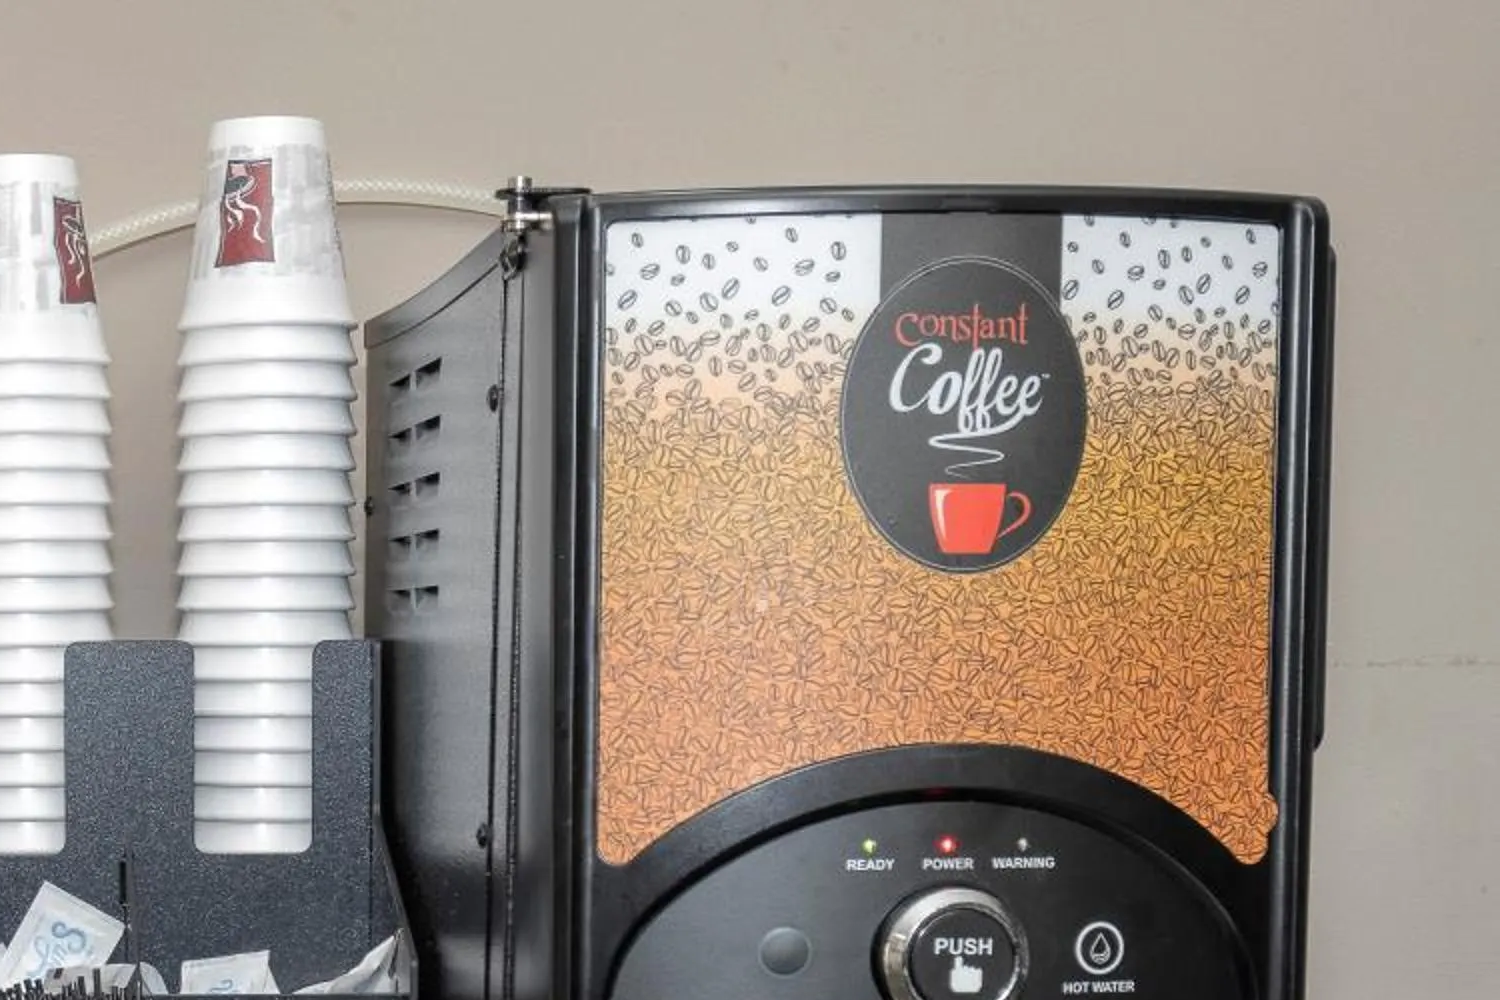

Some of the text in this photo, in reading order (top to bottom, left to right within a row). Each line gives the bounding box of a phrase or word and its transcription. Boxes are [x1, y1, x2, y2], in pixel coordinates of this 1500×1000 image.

[889, 343, 1043, 433] Coffee
[846, 858, 895, 871] READY
[922, 857, 975, 870] POWER
[991, 857, 1056, 870] WARNING
[934, 938, 993, 955] PUSH
[1062, 980, 1135, 993] HOT WATER
